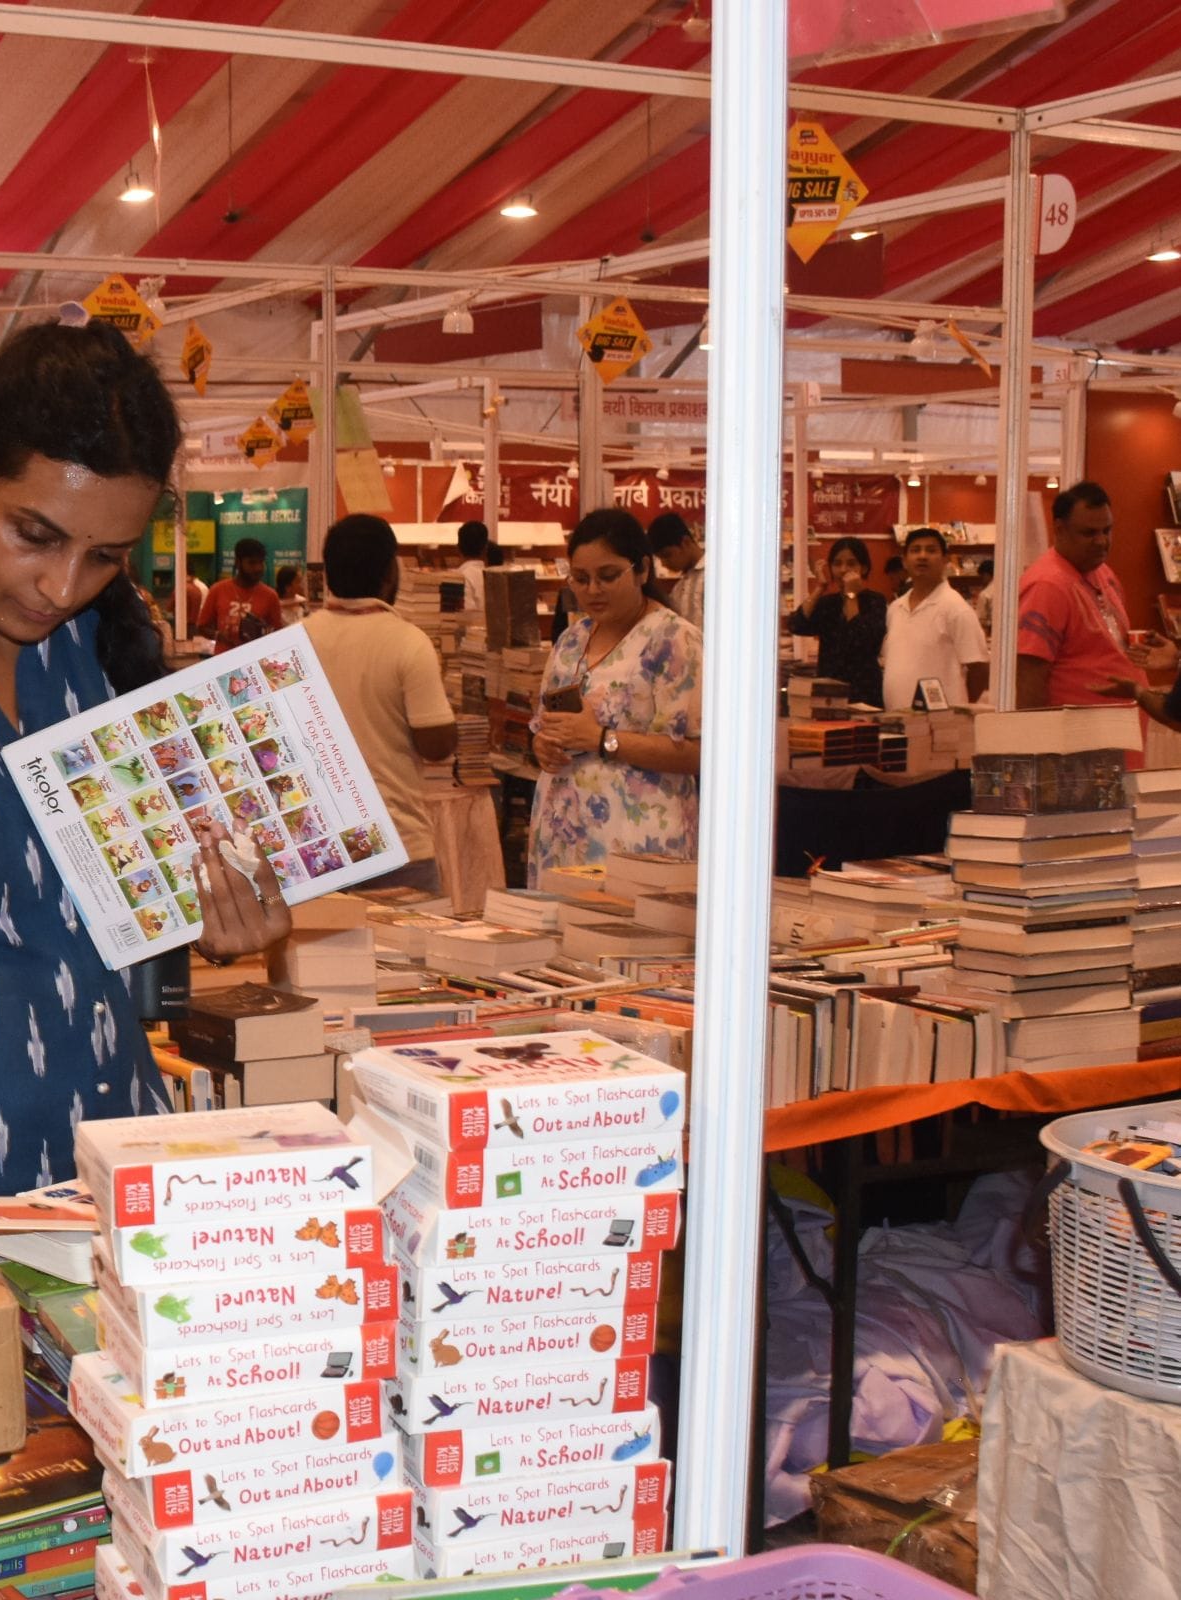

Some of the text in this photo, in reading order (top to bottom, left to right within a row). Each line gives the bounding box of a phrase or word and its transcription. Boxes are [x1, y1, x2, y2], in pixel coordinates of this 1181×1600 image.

[789, 150, 835, 164] ayyar
[804, 181, 836, 197] SALE
[1045, 202, 1069, 227] 48
[530, 475, 573, 508] नयी
[301, 683, 370, 819] A SERIES OF MORAL STORIES
[304, 719, 344, 794] FOR CHILDREN
[26, 756, 65, 816] tricolor
[131, 839, 140, 850] The
[517, 1086, 660, 1109] Lots to Spot Flashcards
[462, 1109, 474, 1139] Kelly
[474, 1106, 485, 1137] Miles
[533, 1108, 645, 1132] Out and About!
[512, 1144, 655, 1167] Lots to Spot Flashcards
[225, 1166, 306, 1191] Nature!
[457, 1166, 469, 1195] Kelly
[469, 1164, 480, 1194] Miles
[541, 1167, 626, 1190] At School!
[125, 1184, 138, 1214] Kelly
[139, 1183, 151, 1213] Miles
[185, 1190, 344, 1213] Lots to Spot Flashcards
[176, 1339, 332, 1369] Lots to Spot Flashcards
[365, 1338, 377, 1367] Miles
[378, 1336, 389, 1366] Kelly
[208, 1363, 300, 1387] At School!
[163, 1400, 317, 1433] Lots to Spot Flashcards
[347, 1399, 359, 1428] Miles
[360, 1395, 372, 1425] Kelly
[179, 1423, 301, 1454] Out and About!
[9, 1458, 90, 1484] Beauty
[18, 1529, 34, 1542] tiny
